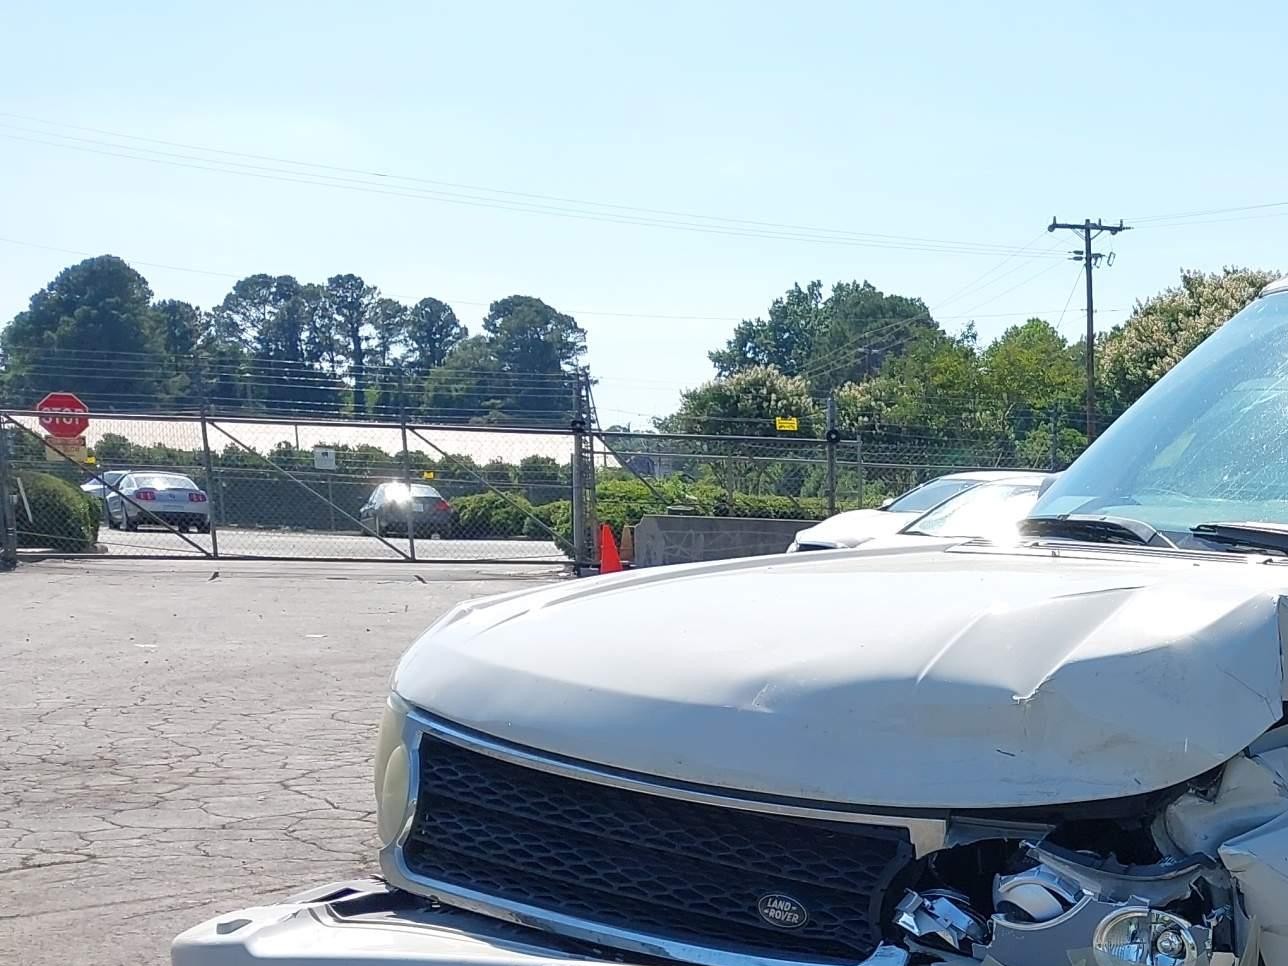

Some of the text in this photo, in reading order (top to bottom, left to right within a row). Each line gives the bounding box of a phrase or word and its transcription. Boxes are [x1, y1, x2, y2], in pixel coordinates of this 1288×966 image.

[41, 407, 84, 424] STOP
[767, 898, 791, 911] LAND
[769, 909, 799, 923] ROVER
